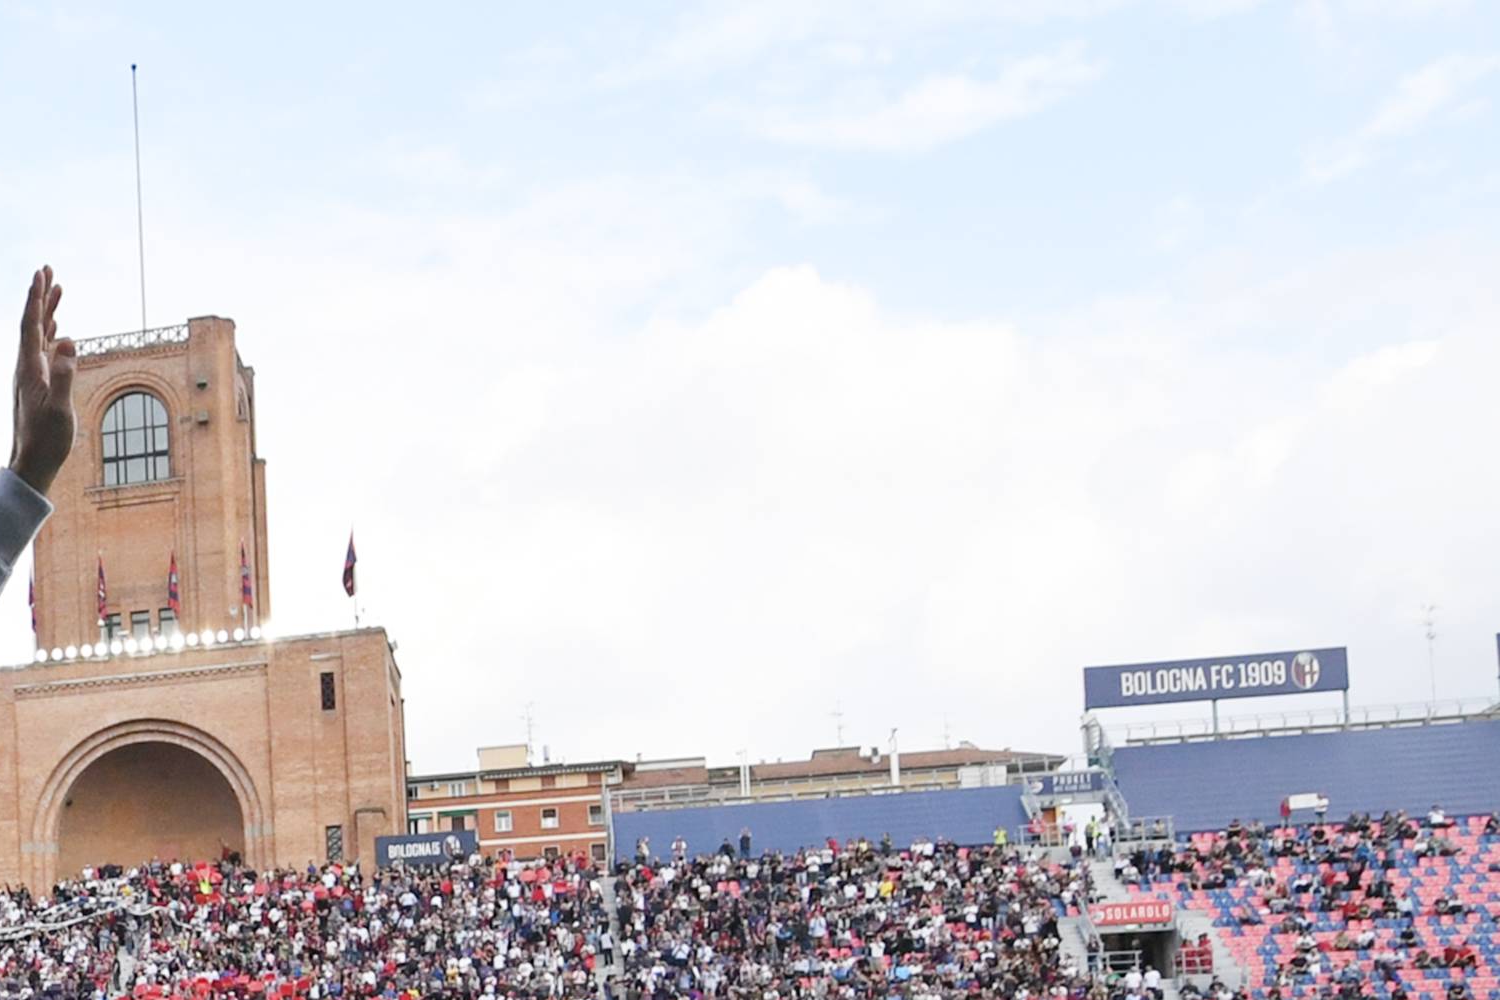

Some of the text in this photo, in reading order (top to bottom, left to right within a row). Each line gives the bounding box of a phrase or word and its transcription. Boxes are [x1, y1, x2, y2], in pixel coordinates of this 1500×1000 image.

[1120, 660, 1286, 697] BOLOGNA FC 1909
[1106, 904, 1170, 920] SOLAROLO
